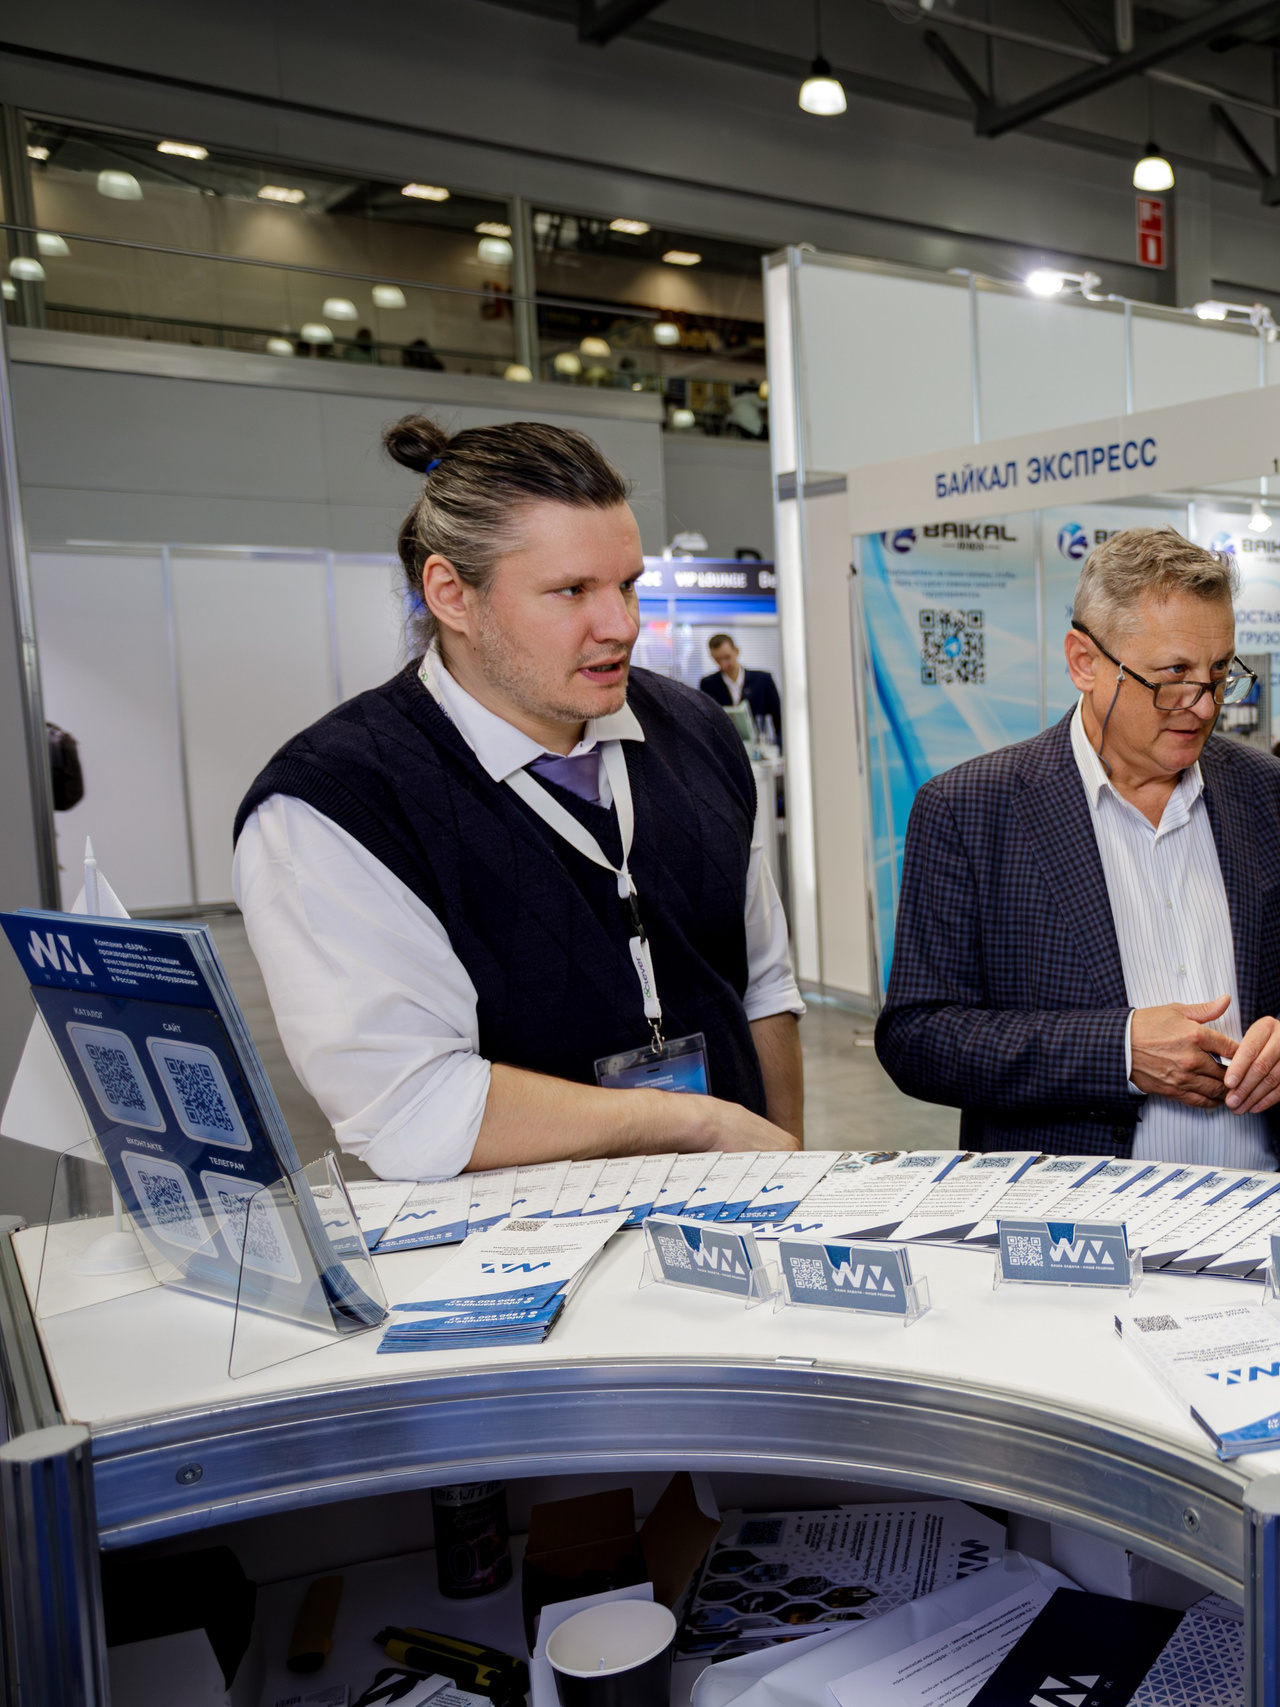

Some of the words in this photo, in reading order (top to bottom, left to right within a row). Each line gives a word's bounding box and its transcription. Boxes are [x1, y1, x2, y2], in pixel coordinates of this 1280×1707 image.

[935, 461, 1019, 499] БАЙКАЛ
[1027, 437, 1158, 485] ЭКСПРЕСС
[923, 521, 1017, 542] BAIKAL
[698, 571, 748, 588] LOUNGE
[92, 938, 123, 949] Компания
[97, 948, 143, 960] производитель
[146, 955, 181, 966] поставщик
[102, 957, 145, 969] качественного
[144, 963, 195, 977] промышленного
[105, 966, 156, 979] теплообменного
[154, 972, 199, 986] оборудования
[115, 975, 140, 985] России.
[73, 1007, 103, 1020] КАТАЛОГ
[162, 1022, 182, 1033] САЙТ
[126, 1137, 164, 1153] ВКОНТАКТЕ
[209, 1156, 246, 1172] ТЕЛЕГРАМ
[446, 1481, 501, 1501] БАЛТИ
